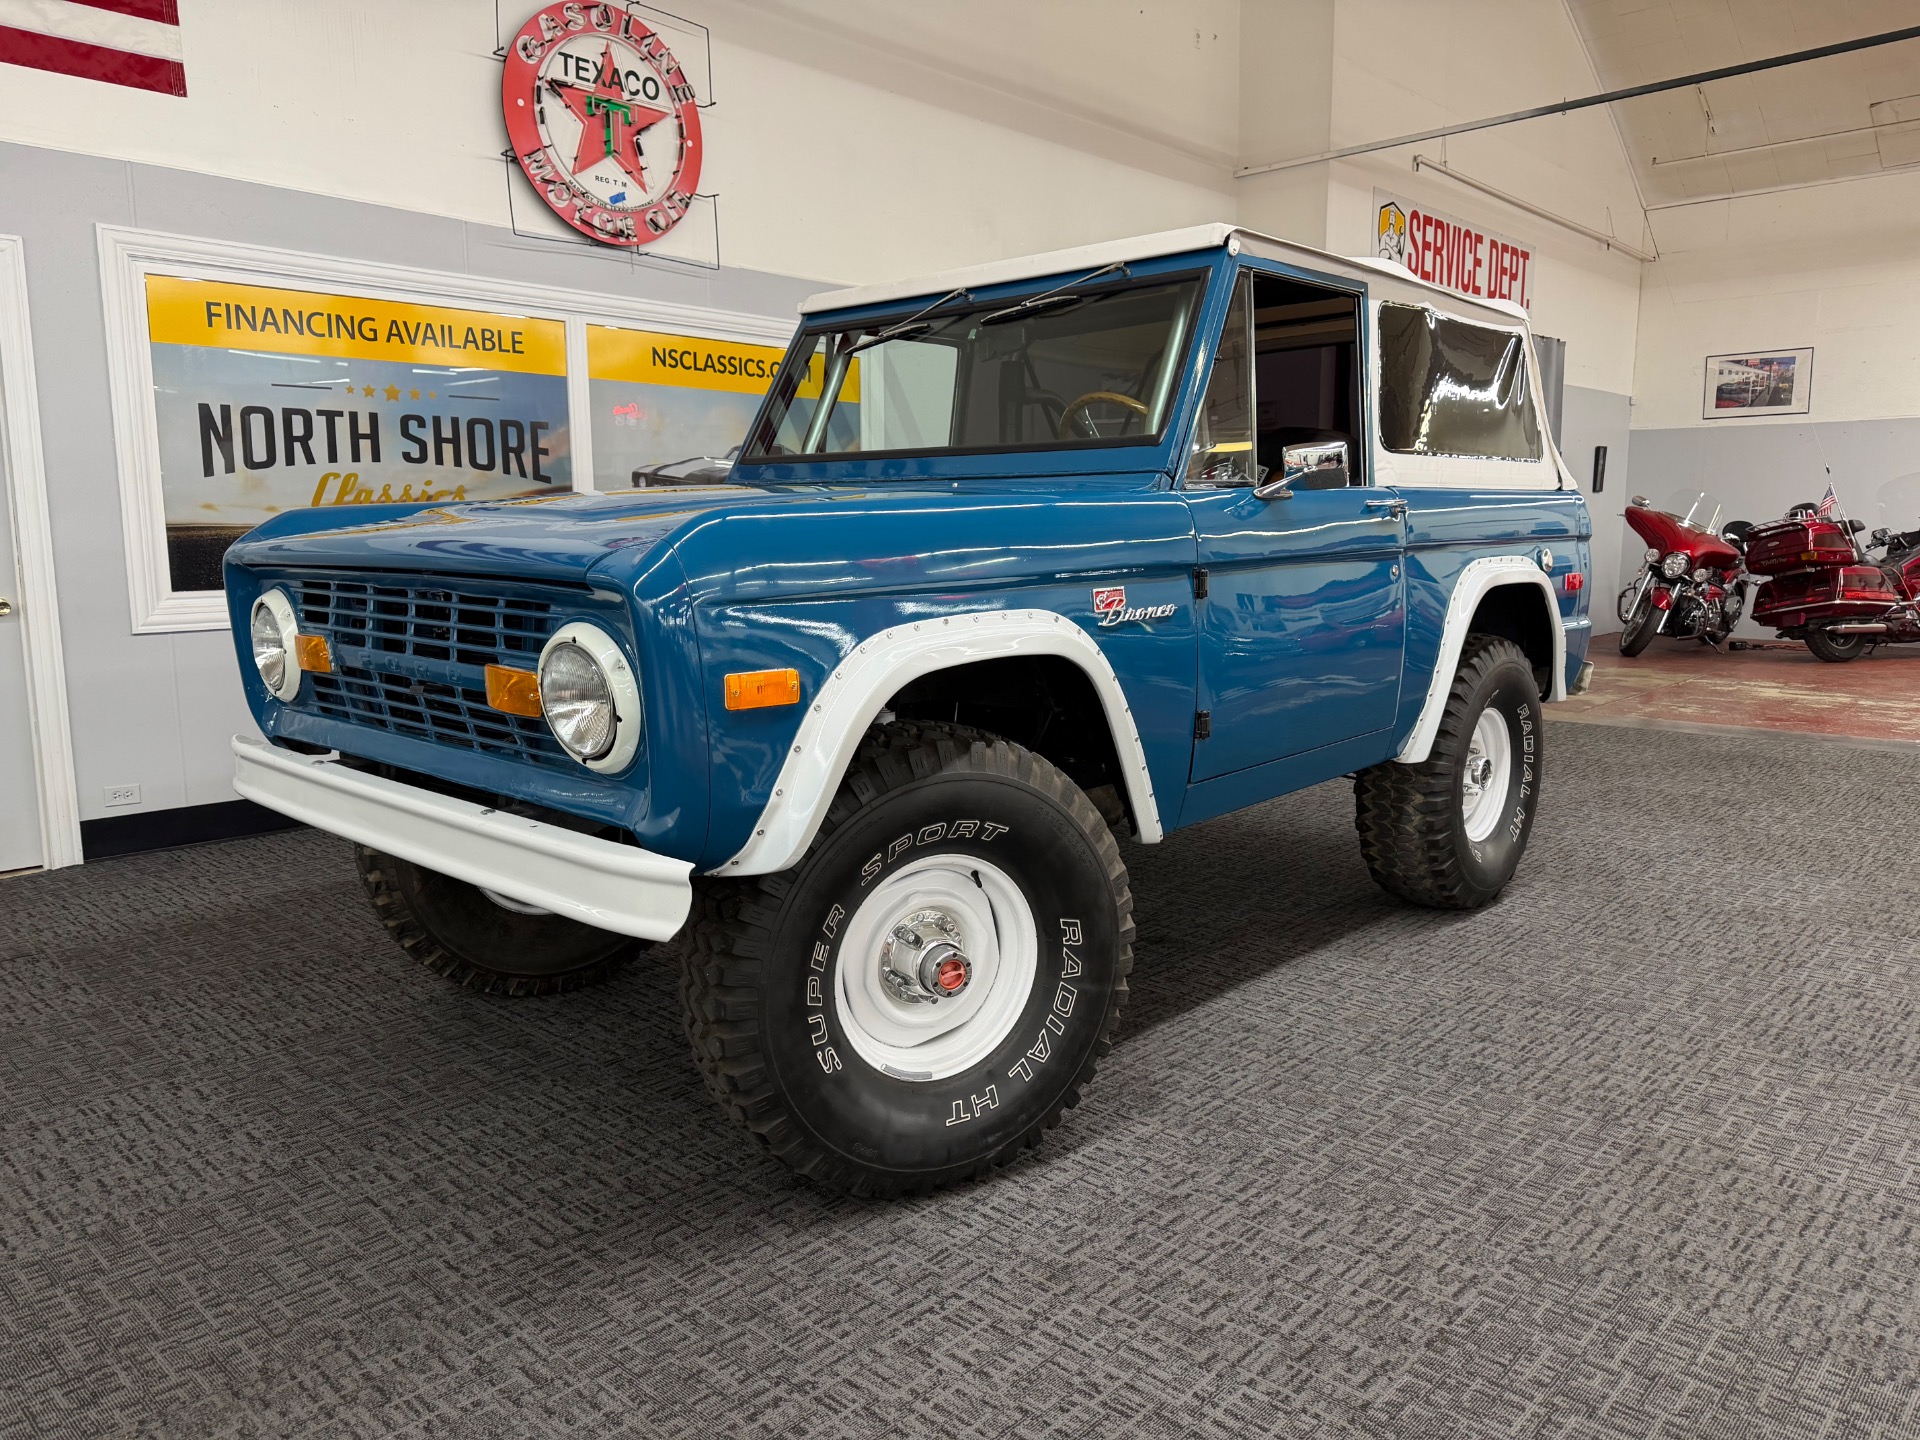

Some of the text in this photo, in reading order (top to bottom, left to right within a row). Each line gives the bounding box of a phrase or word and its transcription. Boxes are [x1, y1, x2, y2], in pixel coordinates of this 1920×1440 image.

[516, 2, 696, 104] GASOLINE
[558, 52, 660, 101] TEXACO
[585, 94, 632, 157] T
[523, 148, 694, 242] MOTOR OIL
[1408, 209, 1529, 309] SERVICE DEPT.
[205, 301, 525, 355] FINANCING AVAILABLE
[652, 346, 812, 383] NSCLASSICS.C
[197, 402, 552, 484] NORTH SHORE
[1098, 596, 1178, 627] Bronco
[1518, 703, 1534, 798] RADIAL
[807, 820, 1009, 1074] SUPER SPORT
[945, 918, 1083, 1127] RADIAL HT
